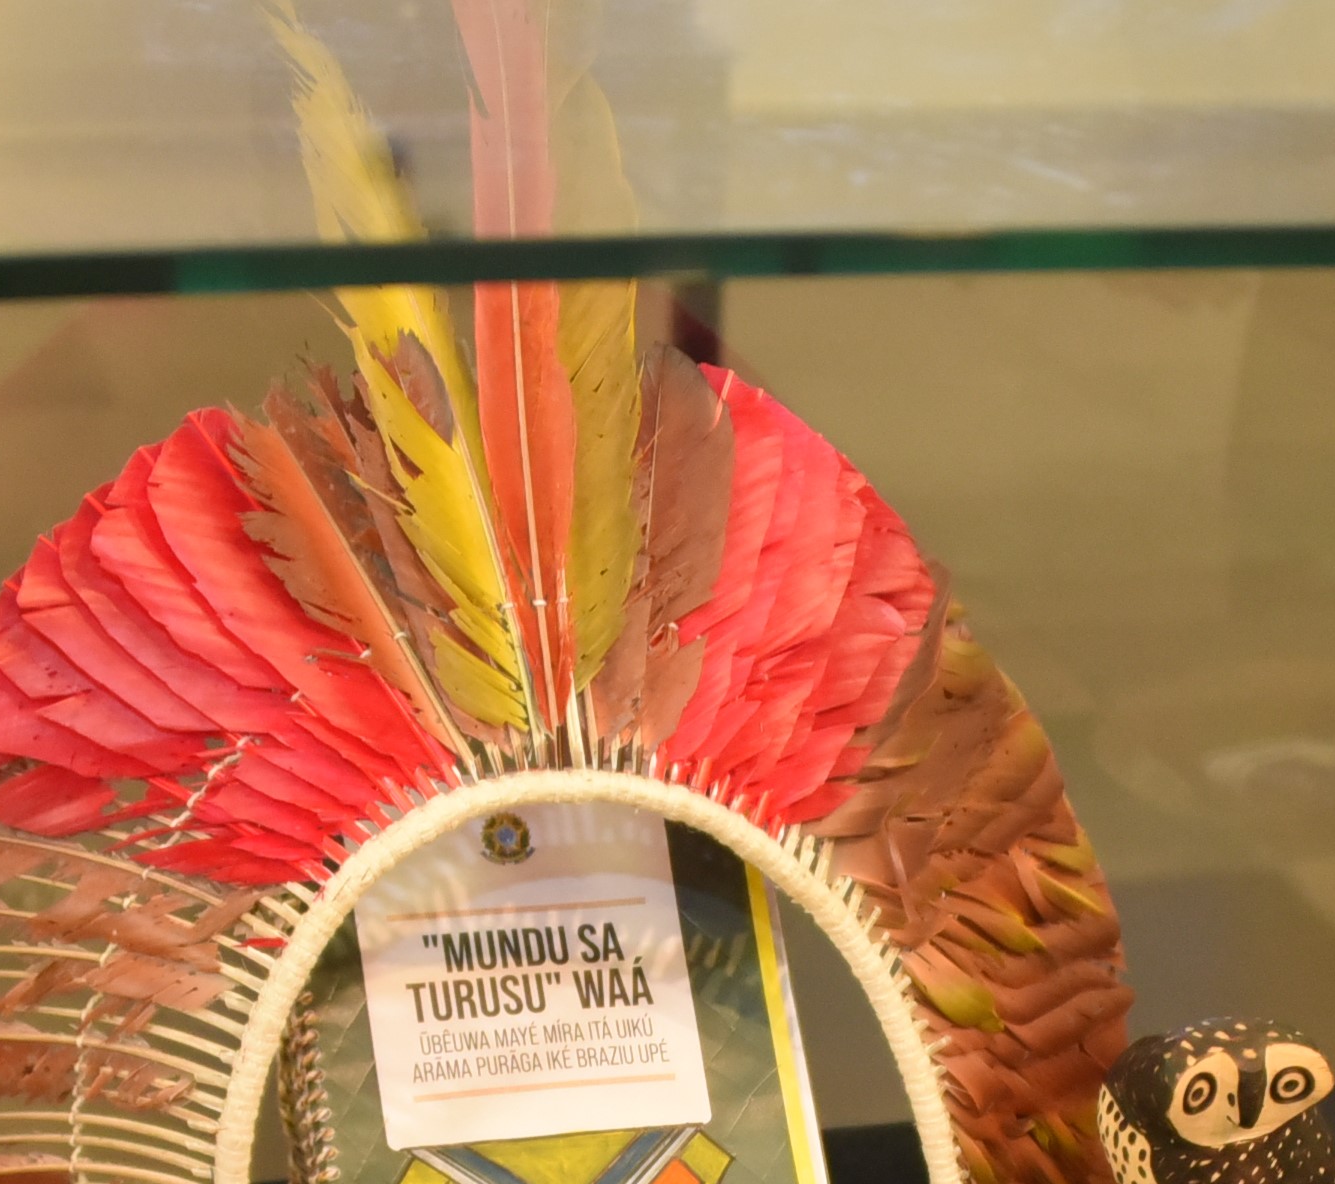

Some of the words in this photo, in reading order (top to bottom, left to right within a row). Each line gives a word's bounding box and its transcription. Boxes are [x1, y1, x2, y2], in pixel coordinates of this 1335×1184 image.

[422, 925, 569, 974] "MUNDU
[577, 922, 625, 964] SA
[405, 971, 561, 1023] TURUSU"
[572, 956, 655, 1010] WAÁ
[494, 1021, 539, 1049] MAYÉ
[543, 1018, 585, 1044] MÍRA
[587, 1015, 614, 1041] ITÁ
[615, 1012, 654, 1039] UIKÚ
[546, 1044, 573, 1071] IKÉ
[576, 1044, 635, 1069] BRAZIU
[638, 1038, 670, 1064] UPÉ
